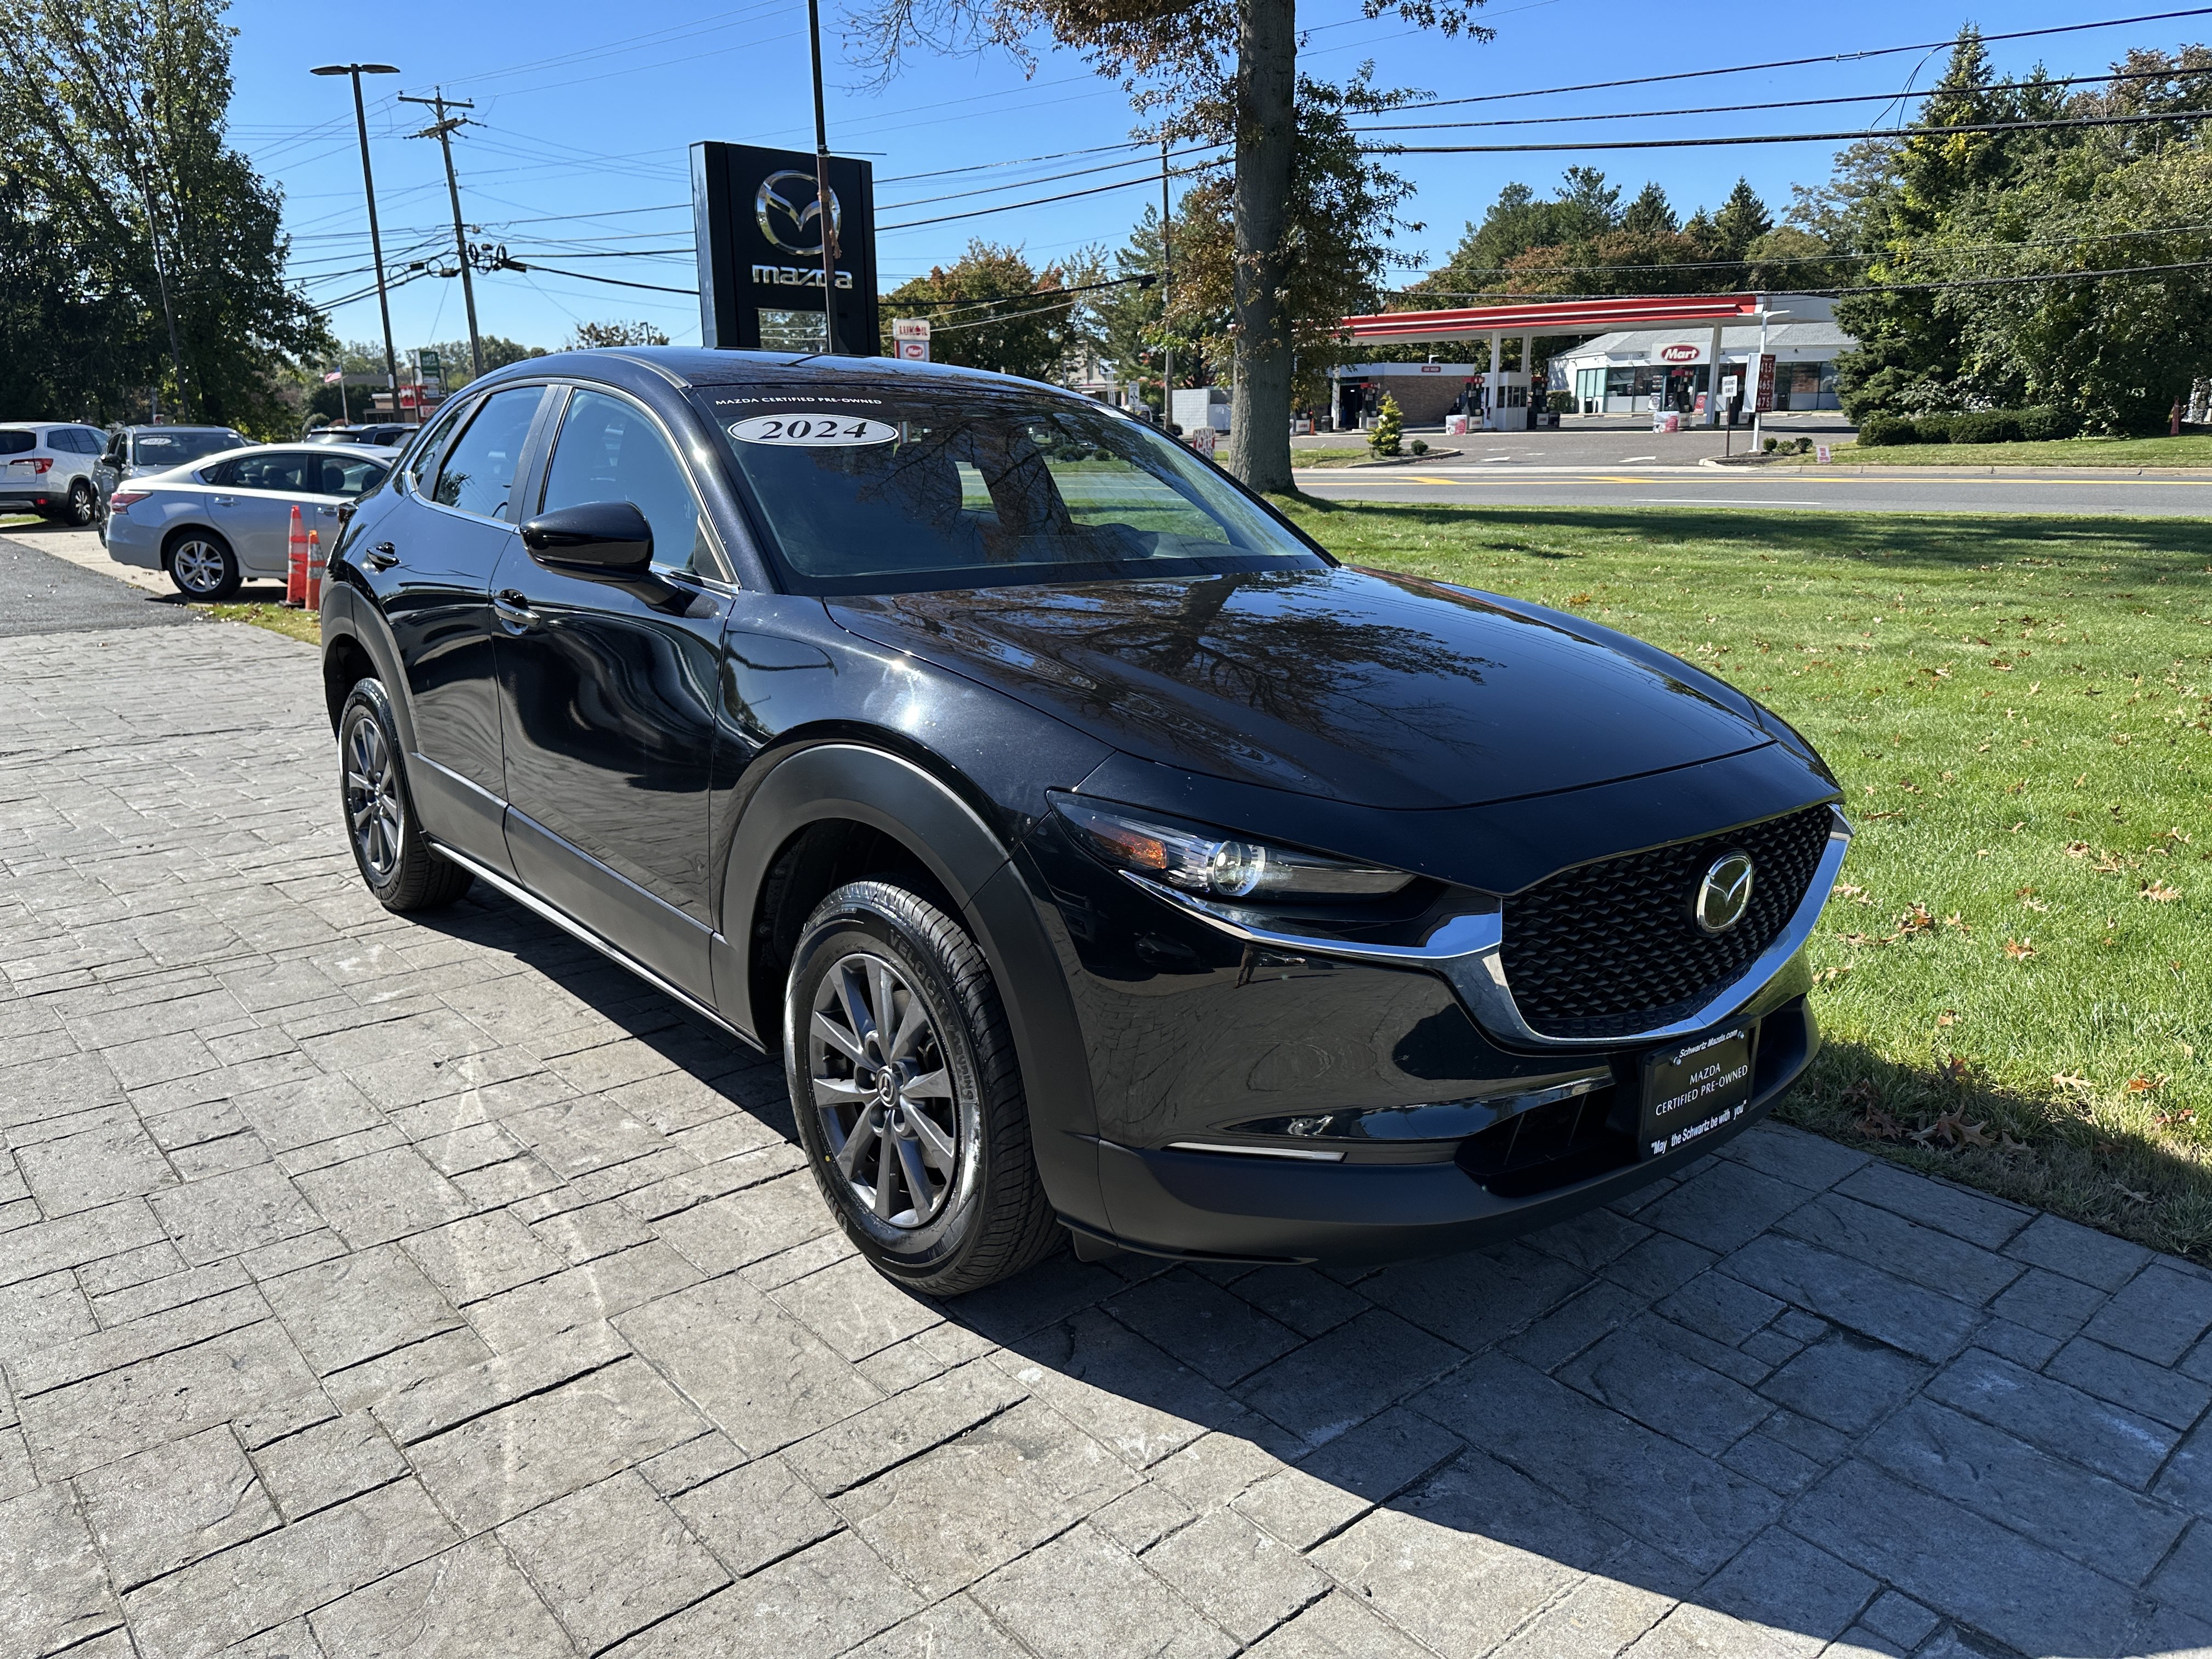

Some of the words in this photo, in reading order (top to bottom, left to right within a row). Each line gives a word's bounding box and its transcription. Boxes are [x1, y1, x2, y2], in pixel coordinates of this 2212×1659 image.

[899, 325, 928, 336] LUKOIL
[1664, 348, 1697, 360] Mart
[758, 420, 867, 439] 2024
[890, 929, 956, 1032] VELOCITY
[1679, 1041, 1707, 1058] Schwartz
[1707, 1029, 1738, 1047] Mazda.com
[1689, 1063, 1720, 1086] MAZDA
[1656, 1088, 1699, 1116] CERTIFIED
[1700, 1065, 1748, 1096] PRE-OWNED
[1651, 1139, 1667, 1154] "May
[1671, 1133, 1681, 1147] the
[1682, 1119, 1710, 1142] Schwartz
[1710, 1116, 1718, 1128] be
[1718, 1108, 1730, 1124] with
